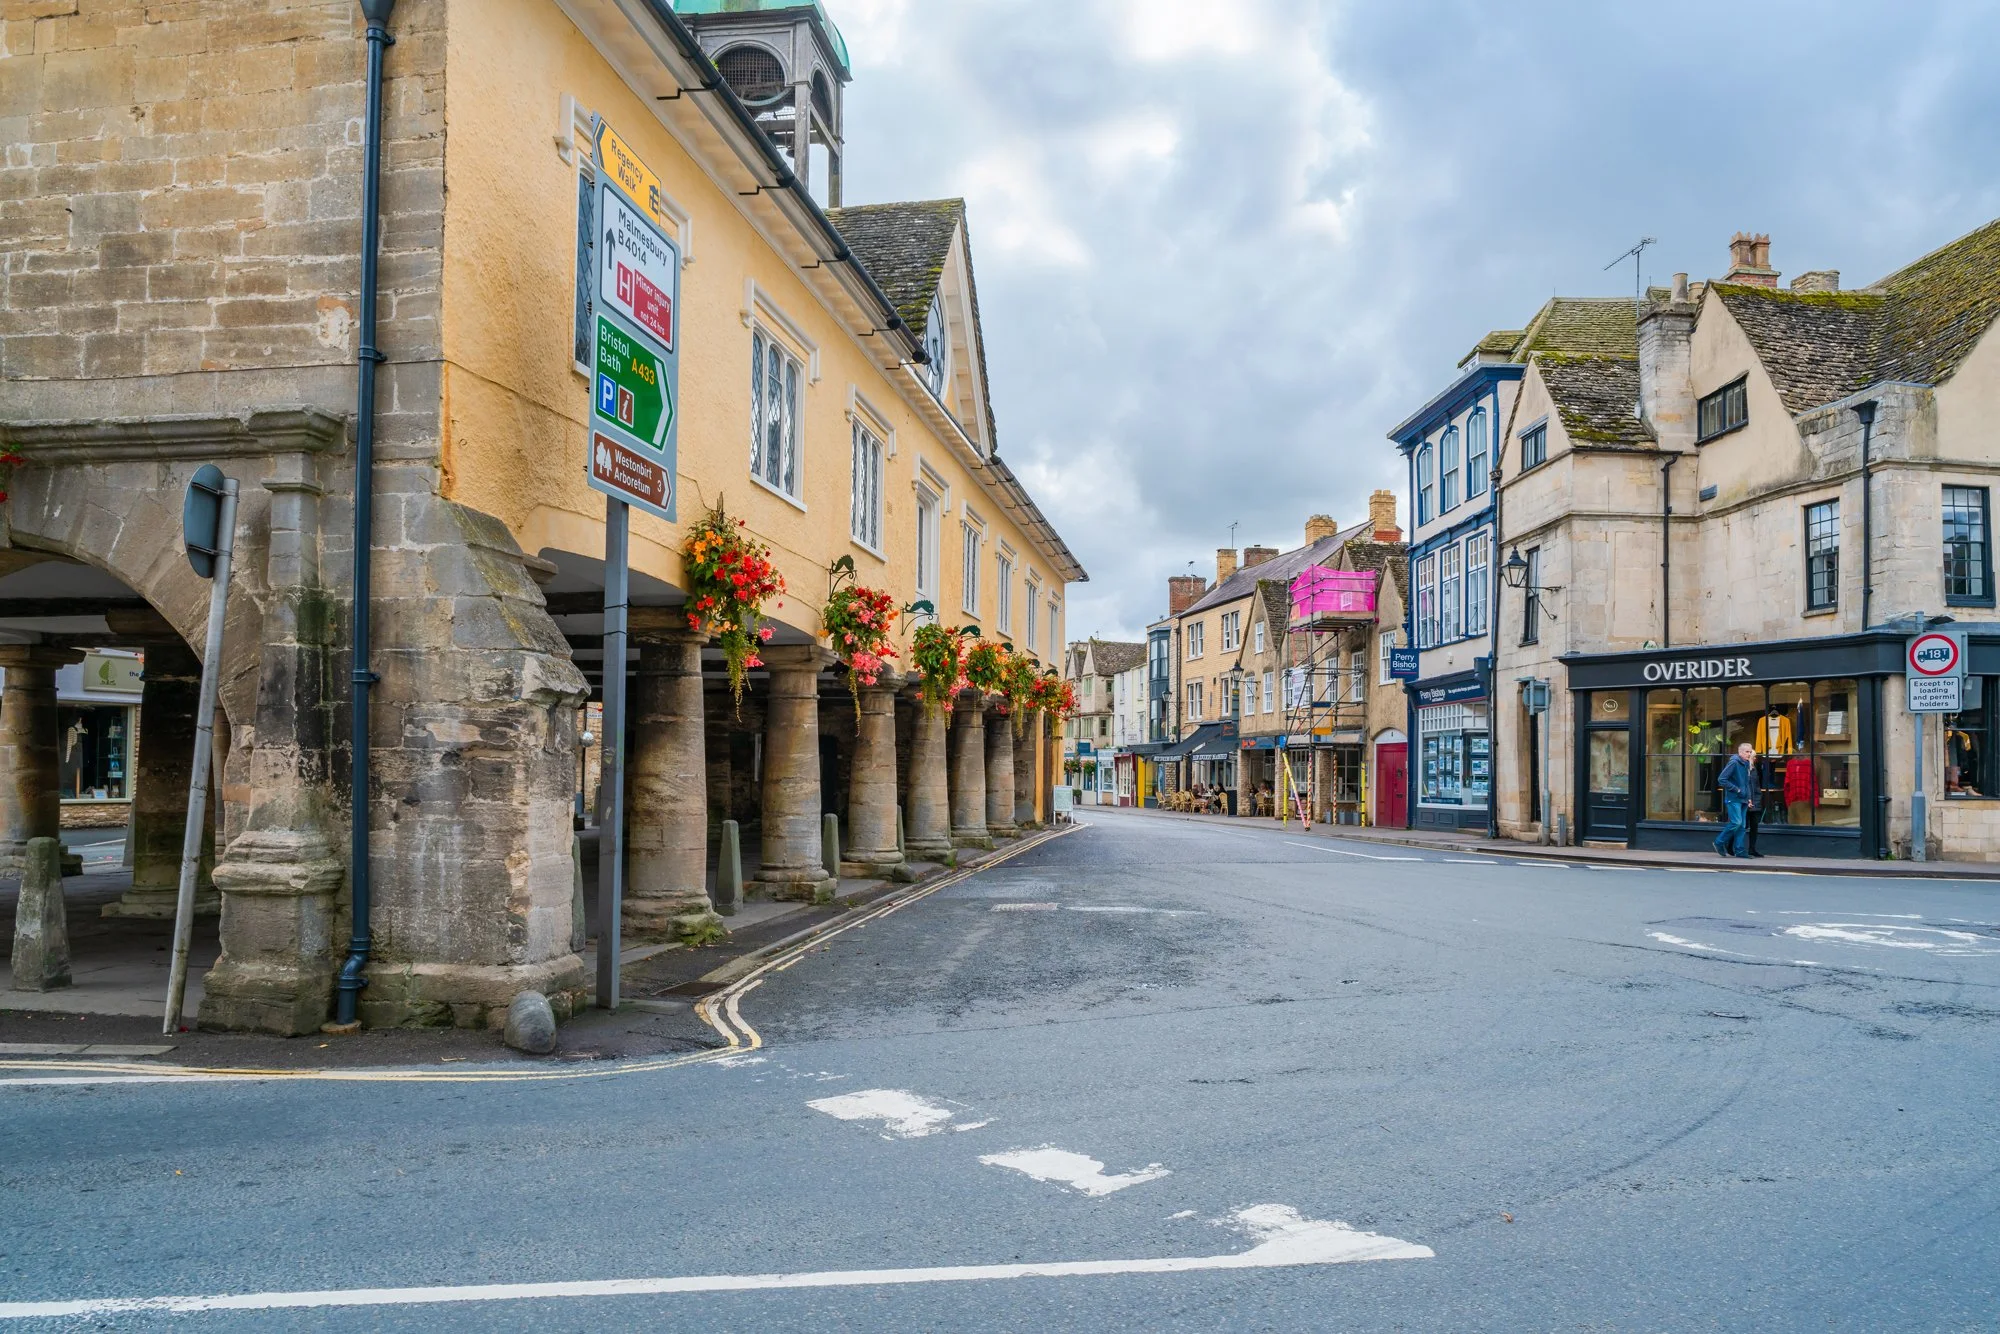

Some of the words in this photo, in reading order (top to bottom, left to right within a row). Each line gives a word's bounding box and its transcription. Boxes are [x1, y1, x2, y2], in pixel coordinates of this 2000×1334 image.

[611, 138, 643, 184] Regency
[617, 163, 637, 193] Walk
[618, 207, 667, 267] Malmesbury
[618, 228, 647, 266] B4014
[619, 267, 631, 302] H
[635, 273, 653, 296] Minor
[654, 289, 671, 313] injury
[640, 311, 649, 324] not
[650, 317, 657, 330] 24
[657, 322, 665, 335] hrs
[647, 301, 659, 317] unit
[601, 324, 630, 359] Bristol
[600, 345, 621, 373] Bath
[631, 357, 655, 385] A433
[602, 379, 614, 409] P
[614, 449, 653, 480] Westonbirt
[614, 467, 651, 496] Arboretum
[657, 480, 662, 492] 3
[1392, 661, 1417, 669] Bishop
[1395, 653, 1414, 662] Perry
[1643, 657, 1753, 681] OVERIDER
[1420, 690, 1432, 701] Perry
[1431, 688, 1445, 699] Bishop
